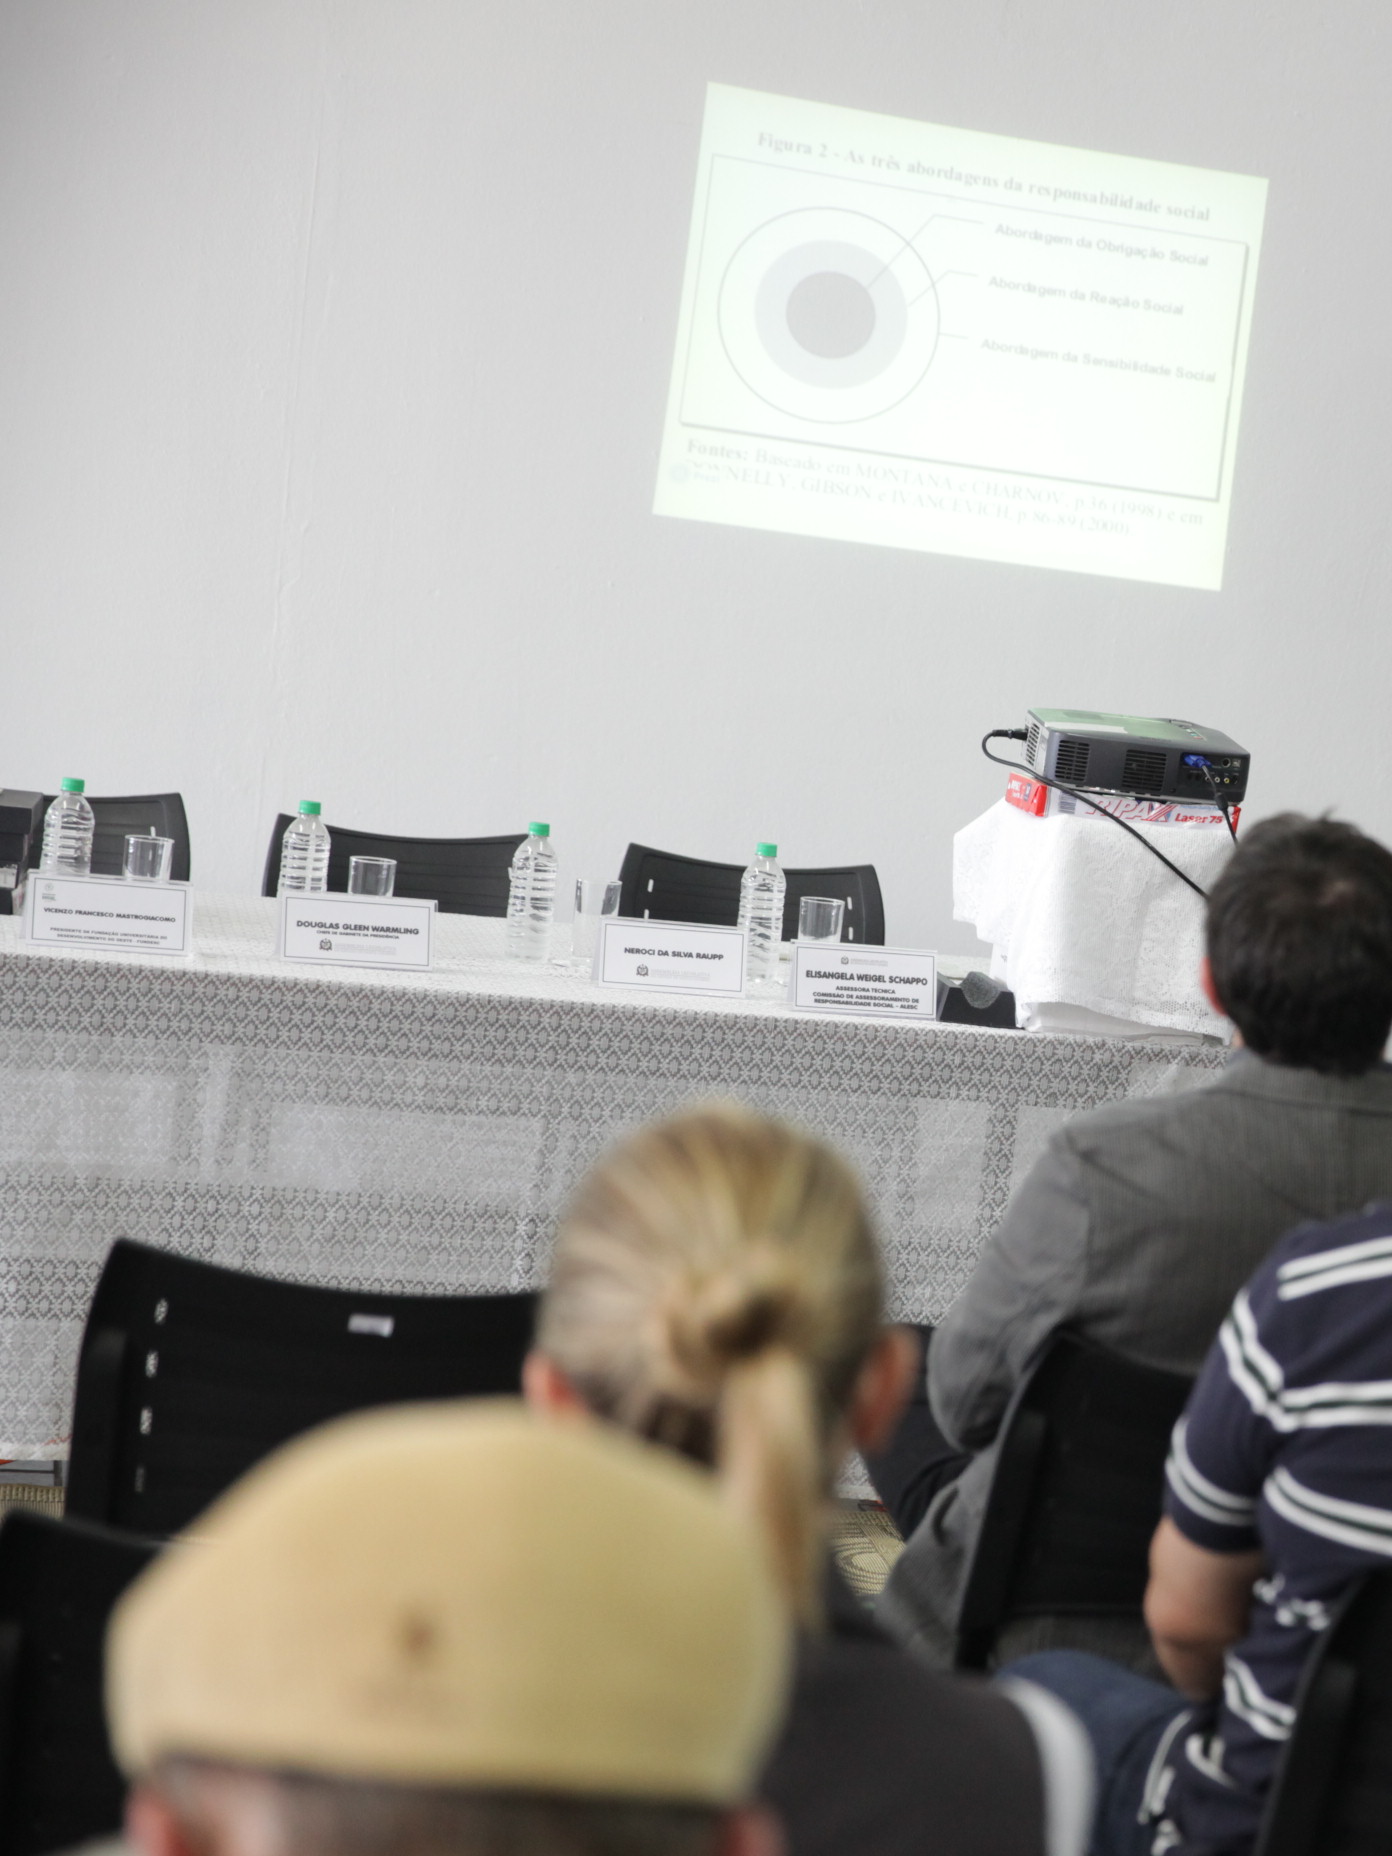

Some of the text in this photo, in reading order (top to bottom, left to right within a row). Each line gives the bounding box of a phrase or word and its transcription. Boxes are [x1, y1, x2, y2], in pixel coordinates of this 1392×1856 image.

[757, 131, 812, 154] Figura
[818, 143, 828, 158] 2
[844, 150, 864, 164] As
[871, 155, 901, 171] três
[907, 161, 999, 188] abordagens
[1004, 177, 1023, 192] da
[1028, 182, 1161, 213] responsabilidade
[1166, 207, 1210, 221] social
[995, 223, 1209, 266] Abordagem da Obrigação Social
[988, 276, 1184, 316] Abordagem da Reação Social
[980, 339, 1216, 383] Abordagem da Sensibilidade Social
[687, 438, 749, 461] Fontes:
[755, 447, 822, 471] Baseado
[827, 464, 850, 476] em
[855, 462, 952, 490] MONTANA
[1180, 513, 1202, 525] em
[800, 476, 871, 499] GIBSON
[1175, 813, 1223, 824] Laser 75
[75, 910, 114, 918] FRANCESCO
[296, 920, 420, 935] DOUGLAS GLEEN WARMLING
[624, 947, 655, 956] NEROCI
[696, 952, 724, 960] RAUPP
[805, 970, 928, 986] ELISANGELA WEIGEL SCHAPPO
[814, 998, 872, 1007] RESPONSABILIDADE
[855, 994, 911, 1004] ASSESSORAMENTO
